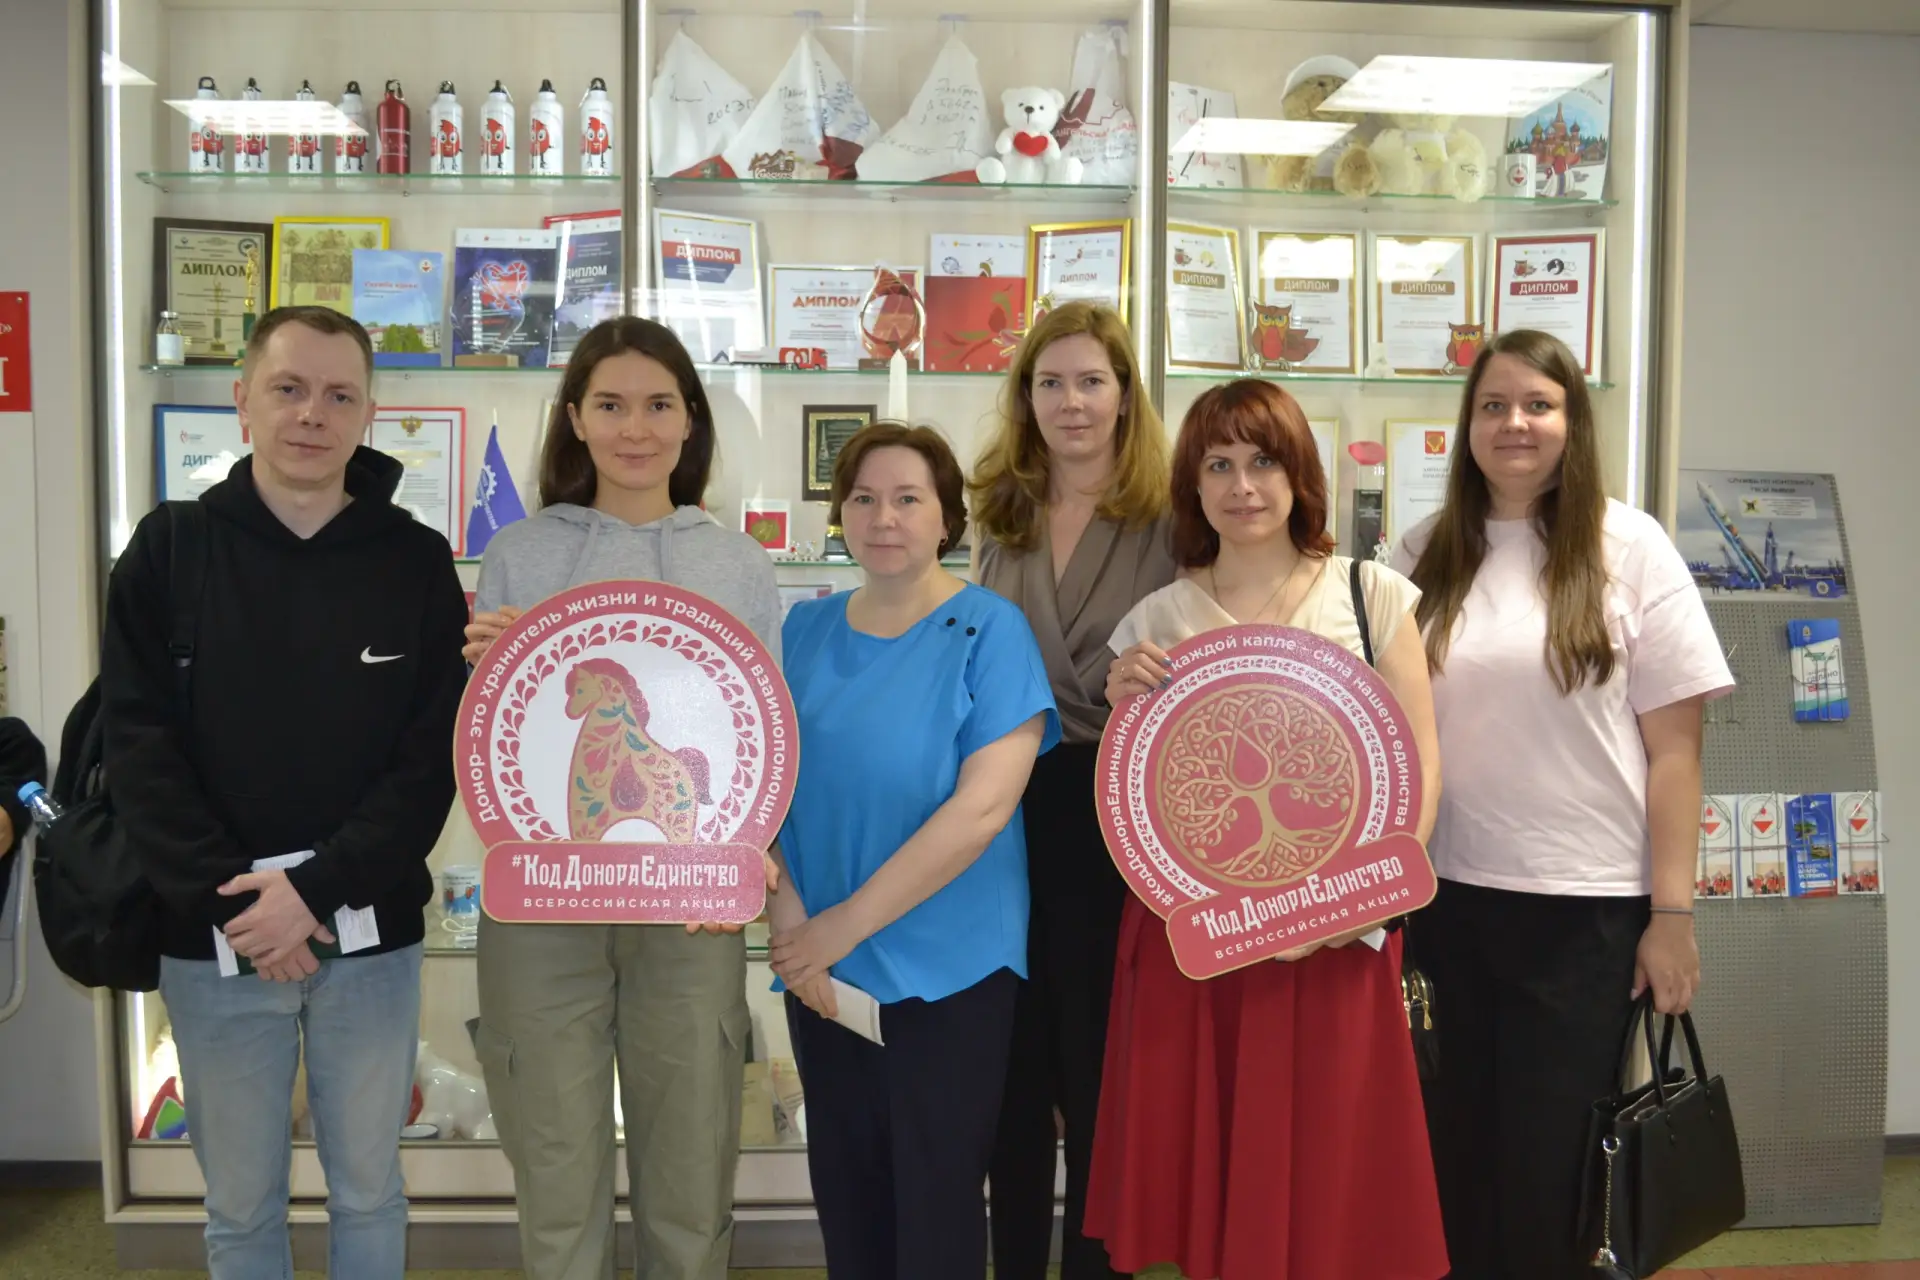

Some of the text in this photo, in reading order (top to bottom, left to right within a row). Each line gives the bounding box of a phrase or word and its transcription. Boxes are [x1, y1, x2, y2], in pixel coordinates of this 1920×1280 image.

[675, 245, 736, 261] ДИПЛОМ
[181, 263, 248, 277] ДИПЛОМ
[565, 265, 608, 279] ДИПЛОМ
[1060, 273, 1098, 284] ДИПЛОМ
[1181, 273, 1218, 286] ДИПЛОМ
[1284, 279, 1330, 292] ДИПЛОМ
[1400, 282, 1446, 294] ДИПЛОМ
[1518, 283, 1569, 295] ДИПЛОМ
[792, 295, 860, 308] ДИПЛОМ
[470, 703, 487, 738] это
[480, 612, 563, 699] хранитель
[565, 593, 637, 616] жизни
[644, 593, 657, 607] и
[664, 597, 756, 662] традиций
[750, 664, 786, 826] взаимопомощи
[1171, 635, 1237, 672] каждой
[1243, 636, 1297, 651] капле
[1313, 647, 1354, 678] сила
[1353, 678, 1398, 736] нашего
[1392, 740, 1410, 826] единства
[523, 897, 737, 910] ВСЕРОССИЙСКАЯ АКЦИЯ
[1215, 887, 1411, 960] ВСЕРОССИЙСКАЯ АКЦИЯ
